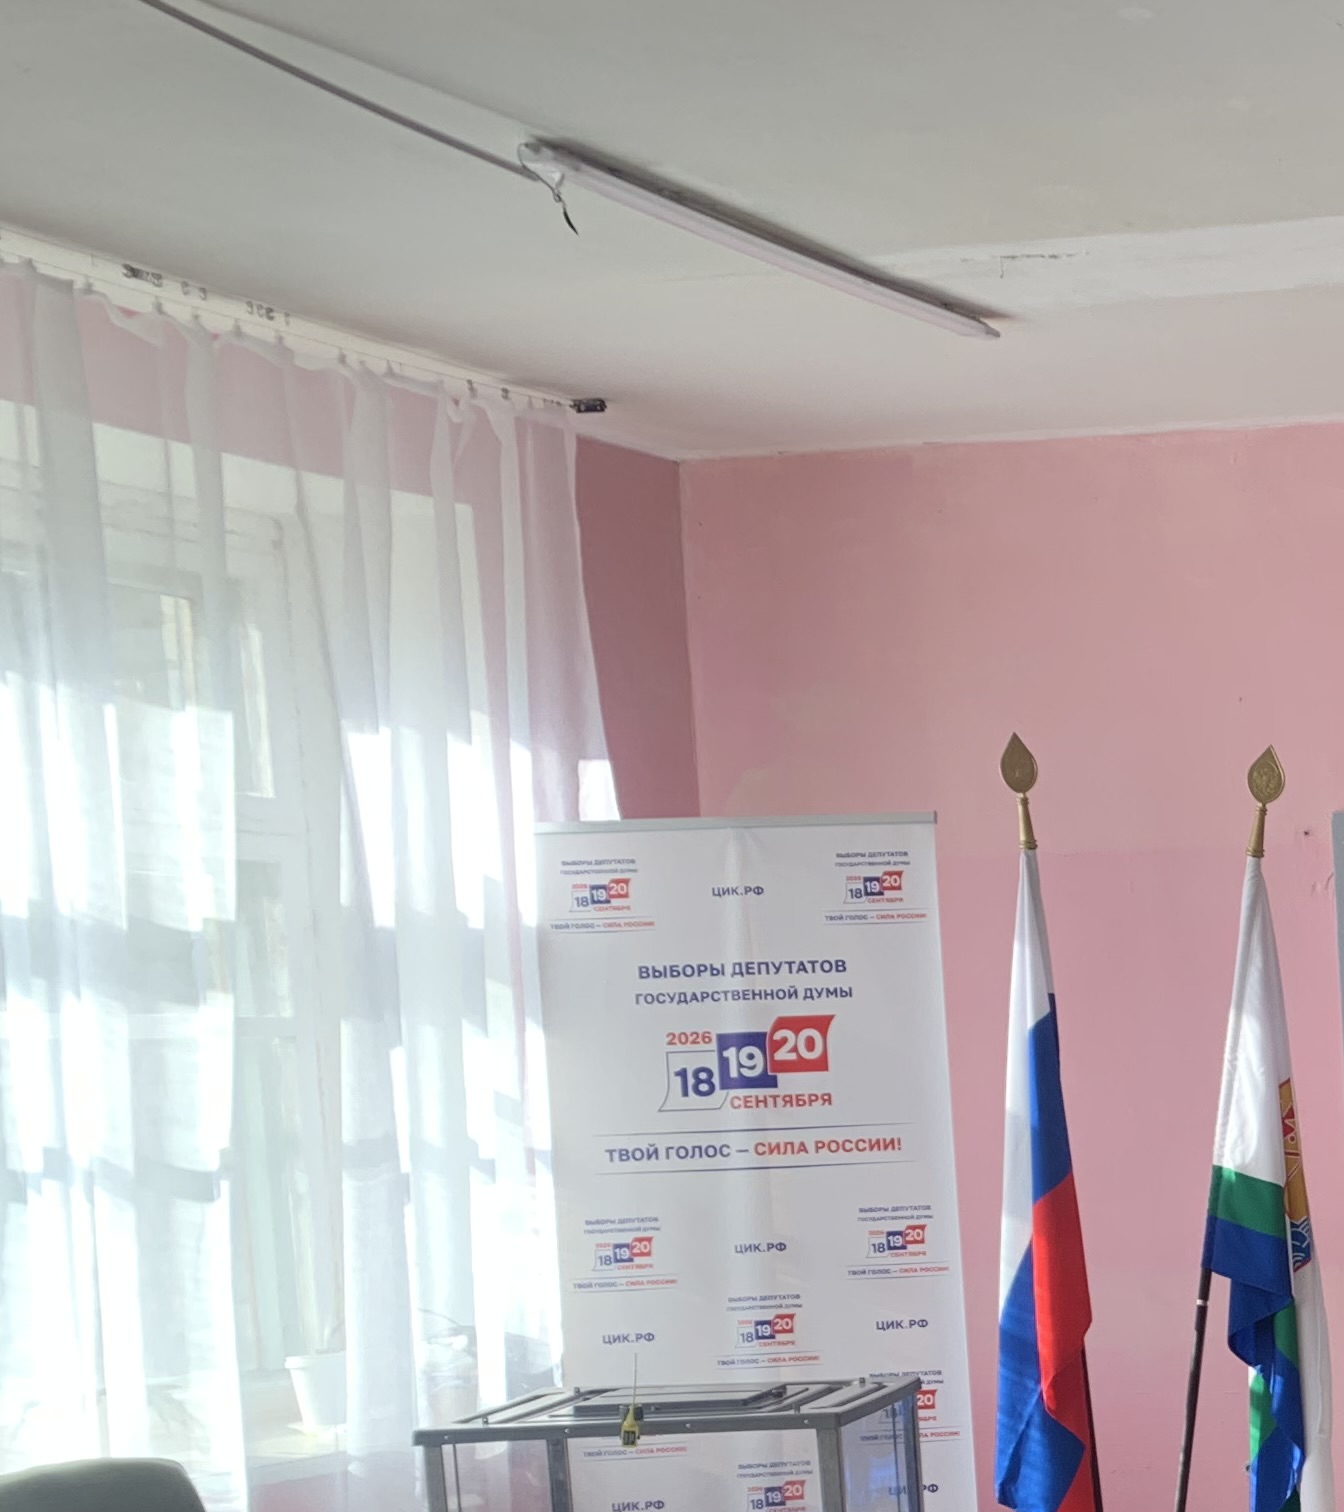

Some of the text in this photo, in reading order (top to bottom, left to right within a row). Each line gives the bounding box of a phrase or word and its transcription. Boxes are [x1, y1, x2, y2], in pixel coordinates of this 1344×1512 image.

[575, 883, 627, 907] 18 19 20
[711, 885, 764, 898] ЦИК.РФ
[848, 875, 900, 899] 18 19 20
[638, 959, 847, 979] ВЫБОРЫ ДЕПУТАТОВ
[635, 985, 852, 1005] ГОСУДАРСТВЕННОЙ ДУМЫ
[666, 1031, 712, 1045] 2026
[674, 1028, 823, 1098] 18 19 20
[730, 1093, 833, 1109] СЕНТЯБРЯ
[605, 1144, 659, 1163] ТВОЙ
[665, 1144, 731, 1160] ГОЛОС
[754, 1141, 809, 1156] СИЛА
[815, 1137, 902, 1153] РОССИИ!
[734, 1241, 787, 1254] ЦИК.РФ
[872, 1229, 923, 1253] 18 19 20
[598, 1241, 650, 1266] 18 19 20
[740, 1318, 792, 1343] 18 19 20
[875, 1318, 929, 1331] ЦИК.РФ
[602, 1332, 655, 1345] ЦИК.РФ
[916, 1394, 934, 1405] 20
[751, 1485, 802, 1510] 18 19 20
